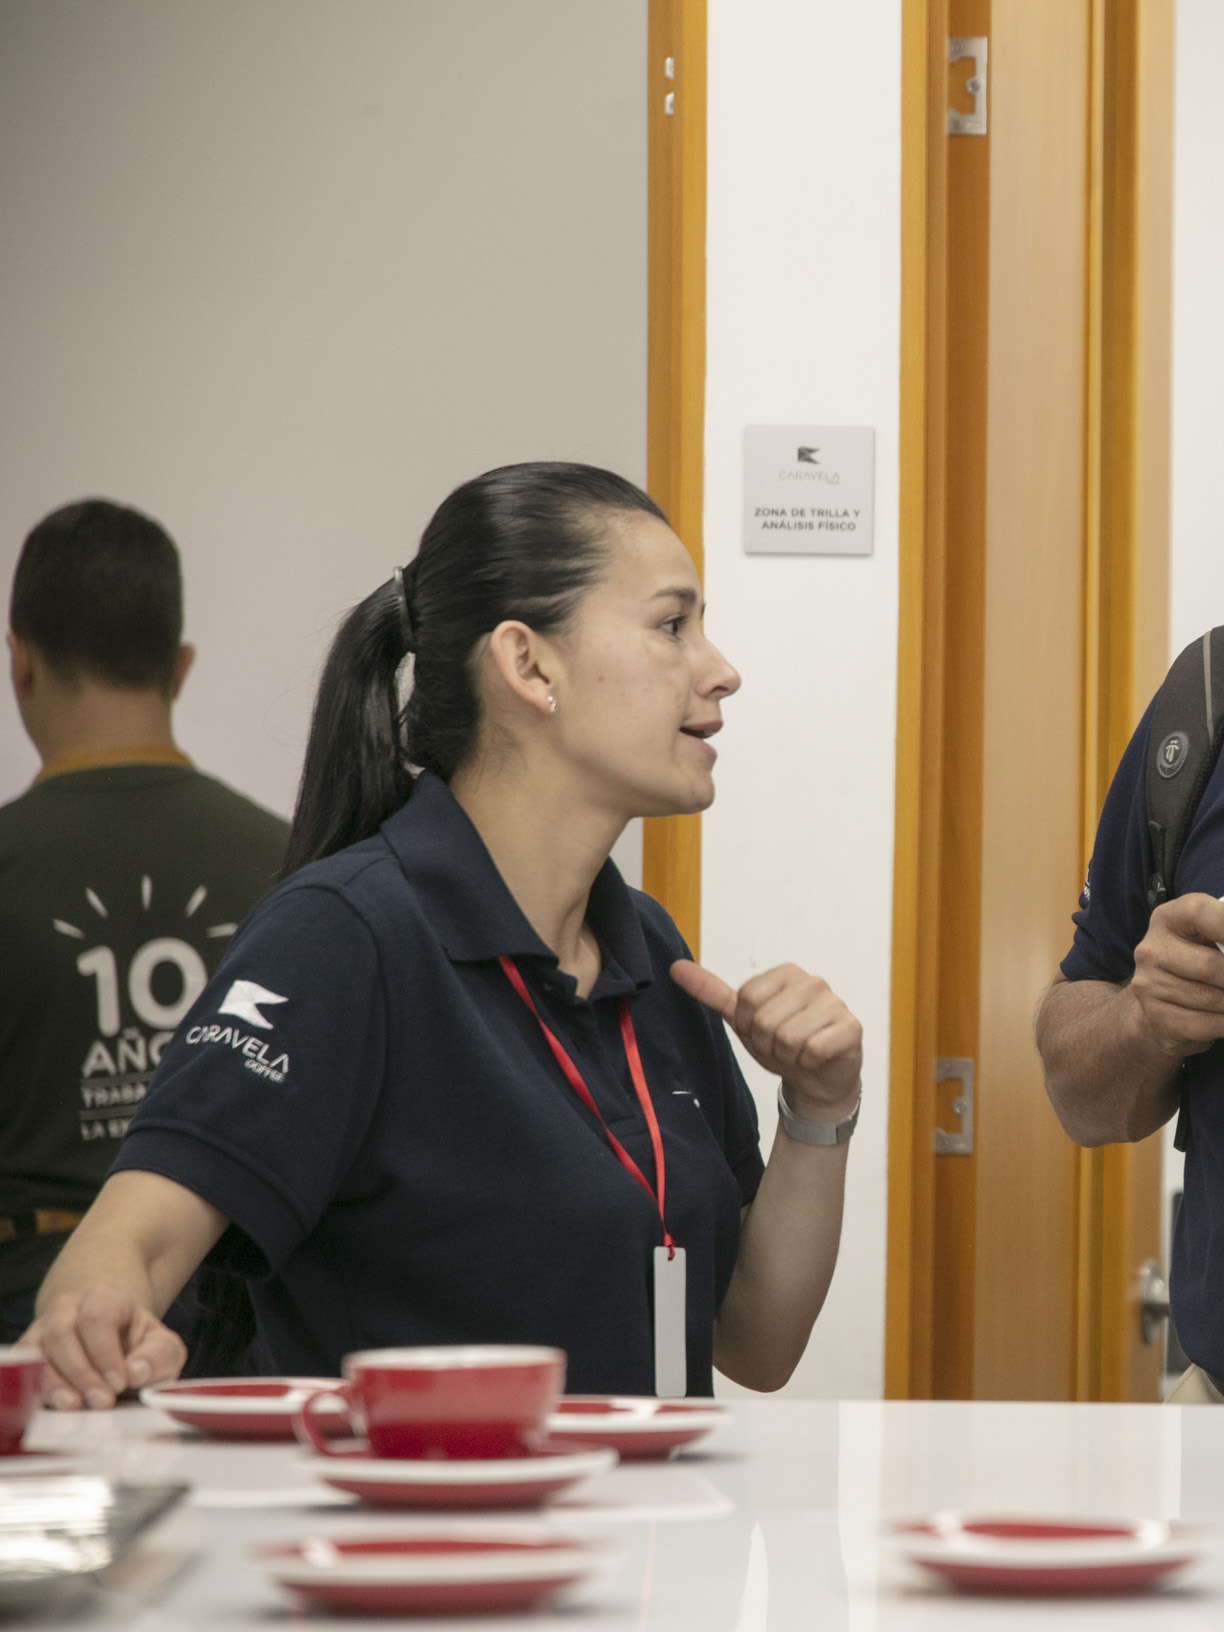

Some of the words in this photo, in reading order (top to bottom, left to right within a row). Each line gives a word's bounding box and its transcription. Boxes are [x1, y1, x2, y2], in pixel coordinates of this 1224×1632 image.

[779, 470, 841, 481] CARAVELA
[754, 507, 787, 517] ZONA
[791, 507, 806, 518] DE
[810, 508, 850, 518] TRILLA
[853, 509, 861, 518] Y
[761, 519, 815, 530] ANÁLISIS
[818, 519, 856, 532] FÍSICO
[76, 936, 208, 1038] 10
[186, 1024, 289, 1074] CARAVELA
